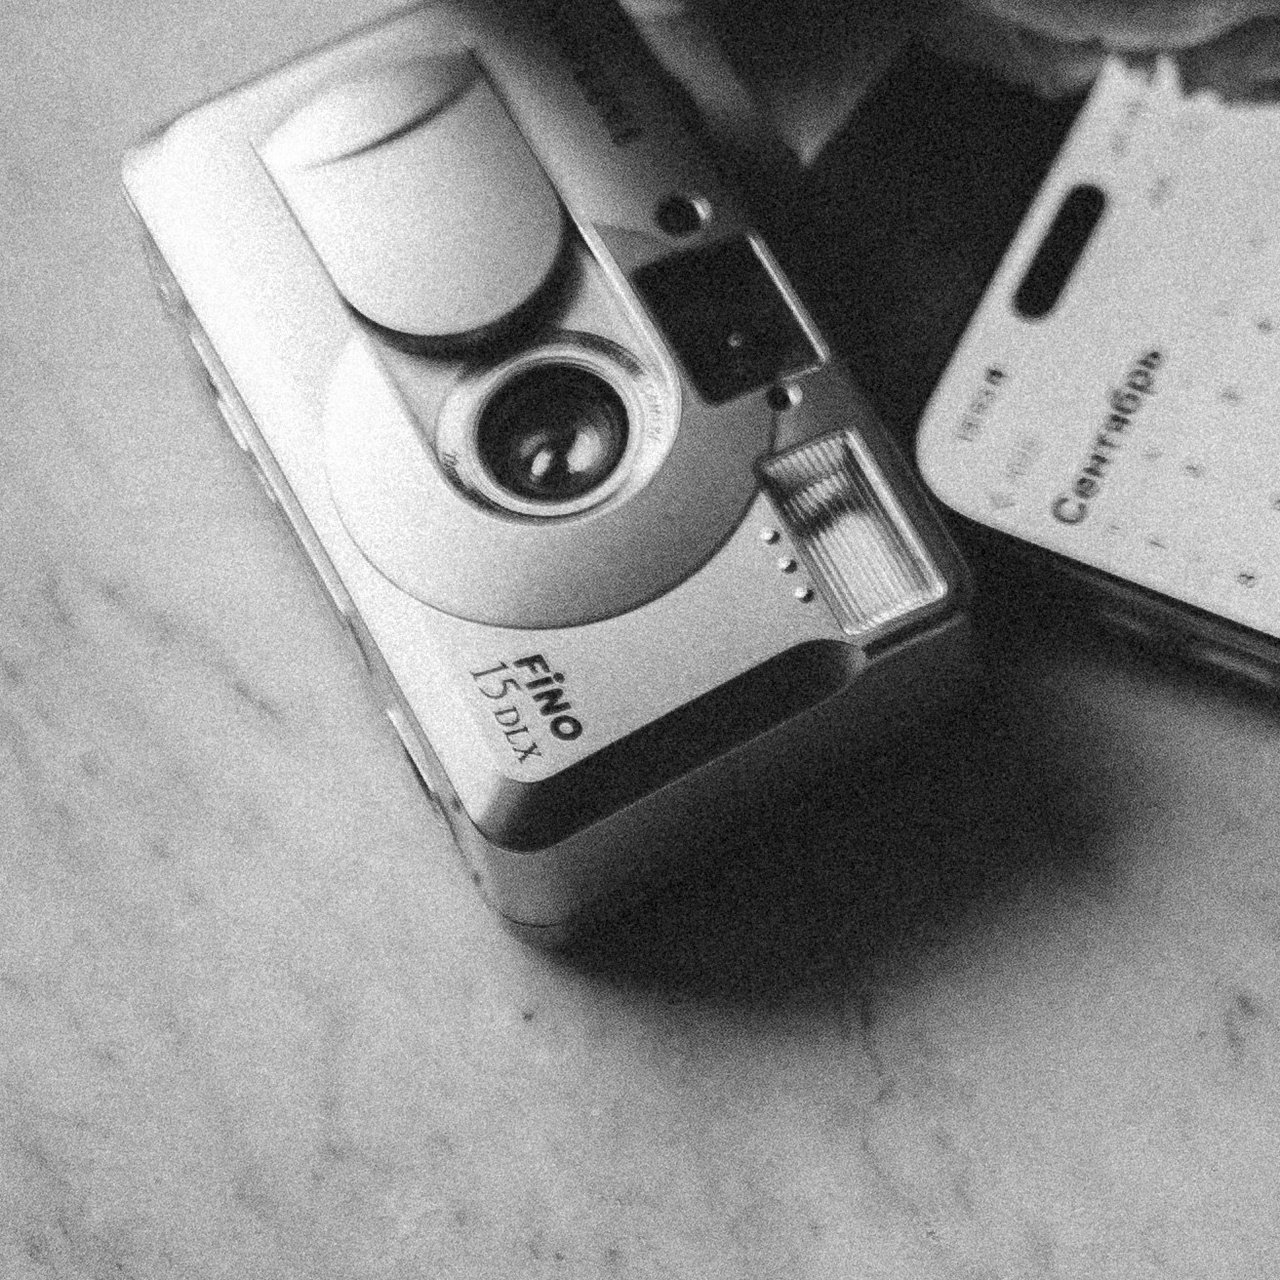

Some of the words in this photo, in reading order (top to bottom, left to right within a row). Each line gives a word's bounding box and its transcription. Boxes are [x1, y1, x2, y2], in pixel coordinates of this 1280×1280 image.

[1051, 350, 1163, 526] Сентябрь
[469, 659, 521, 700] 15
[492, 705, 542, 763] DLX
